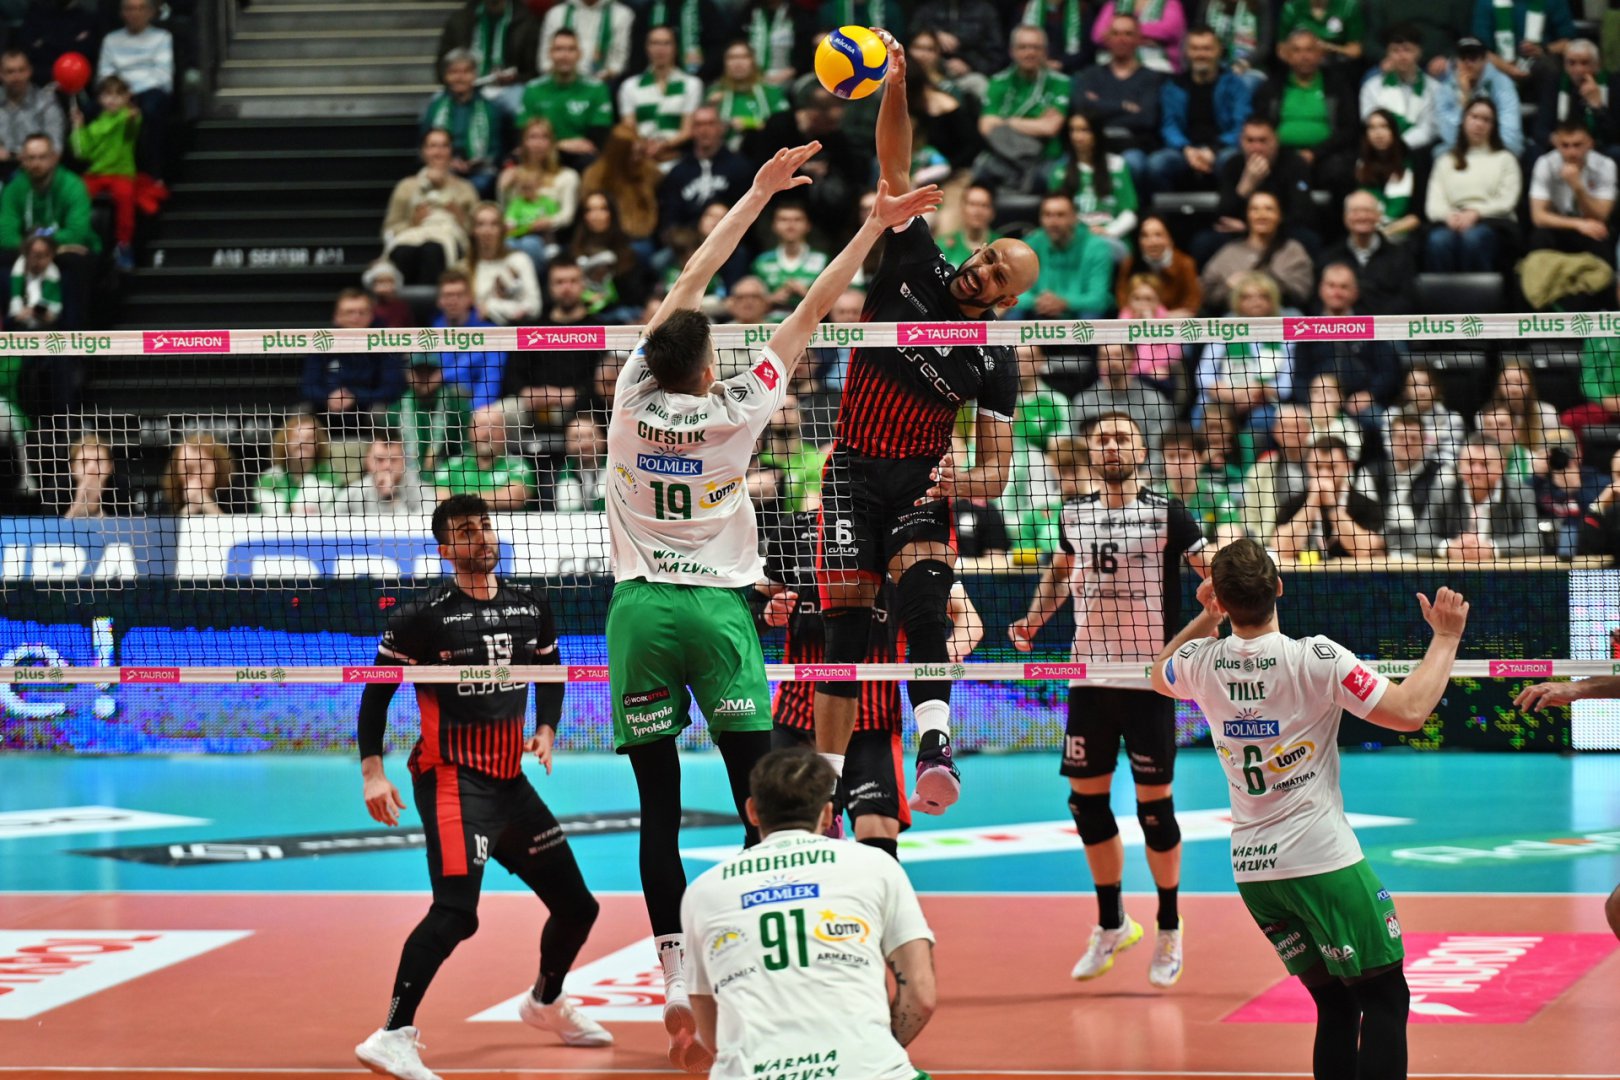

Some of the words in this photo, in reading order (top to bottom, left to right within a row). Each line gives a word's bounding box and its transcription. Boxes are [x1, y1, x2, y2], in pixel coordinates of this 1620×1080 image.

[823, 324, 864, 345] liga
[926, 328, 978, 340] TAURON
[1020, 321, 1066, 342] plus
[1129, 320, 1174, 342] plus
[1207, 319, 1249, 341] liga
[1313, 322, 1366, 334] TAURON
[1409, 317, 1455, 338] plus
[1518, 315, 1565, 336] plus
[71, 332, 111, 353] liga
[171, 336, 222, 347] TAURON
[263, 331, 307, 351] plus
[367, 329, 412, 350] plus
[444, 329, 484, 350] liga
[545, 332, 597, 343] TAURON
[646, 402, 669, 421] plus
[684, 412, 709, 426] liga
[637, 420, 707, 445] CIEŚLIK
[638, 456, 699, 474] POLMLEK
[650, 481, 692, 520] 19
[708, 481, 736, 504] LOTTO
[836, 519, 852, 545] 6
[1091, 542, 1119, 574] 16
[482, 632, 513, 666] 19
[460, 666, 491, 682] plus
[814, 668, 851, 678] TAURON
[914, 665, 946, 679] plus
[1043, 666, 1081, 676] TAURON
[1214, 657, 1241, 671] plus
[1256, 656, 1277, 671] liga
[1377, 661, 1410, 675] plus
[1509, 663, 1548, 673] TAURON
[15, 668, 45, 682] plus
[138, 671, 175, 680] TAURON
[236, 668, 267, 682] plus
[361, 670, 398, 679] TAURON
[1227, 681, 1266, 701] TILLE
[625, 706, 673, 725] Piekarnia
[1225, 722, 1277, 736] POLMLEK
[1065, 734, 1086, 760] 16
[1276, 745, 1307, 768] LOTTO
[1243, 745, 1267, 795] 6
[1271, 770, 1317, 791] ARMATURA
[474, 834, 489, 860] 19
[722, 850, 836, 880] HADRAVA
[743, 885, 817, 909] POLMLEK
[759, 908, 809, 971] 91
[826, 922, 861, 936] LOTTO
[817, 952, 871, 967] ARMATURA
[720, 966, 757, 988] DAMIX
[753, 1049, 837, 1075] WARMIA
